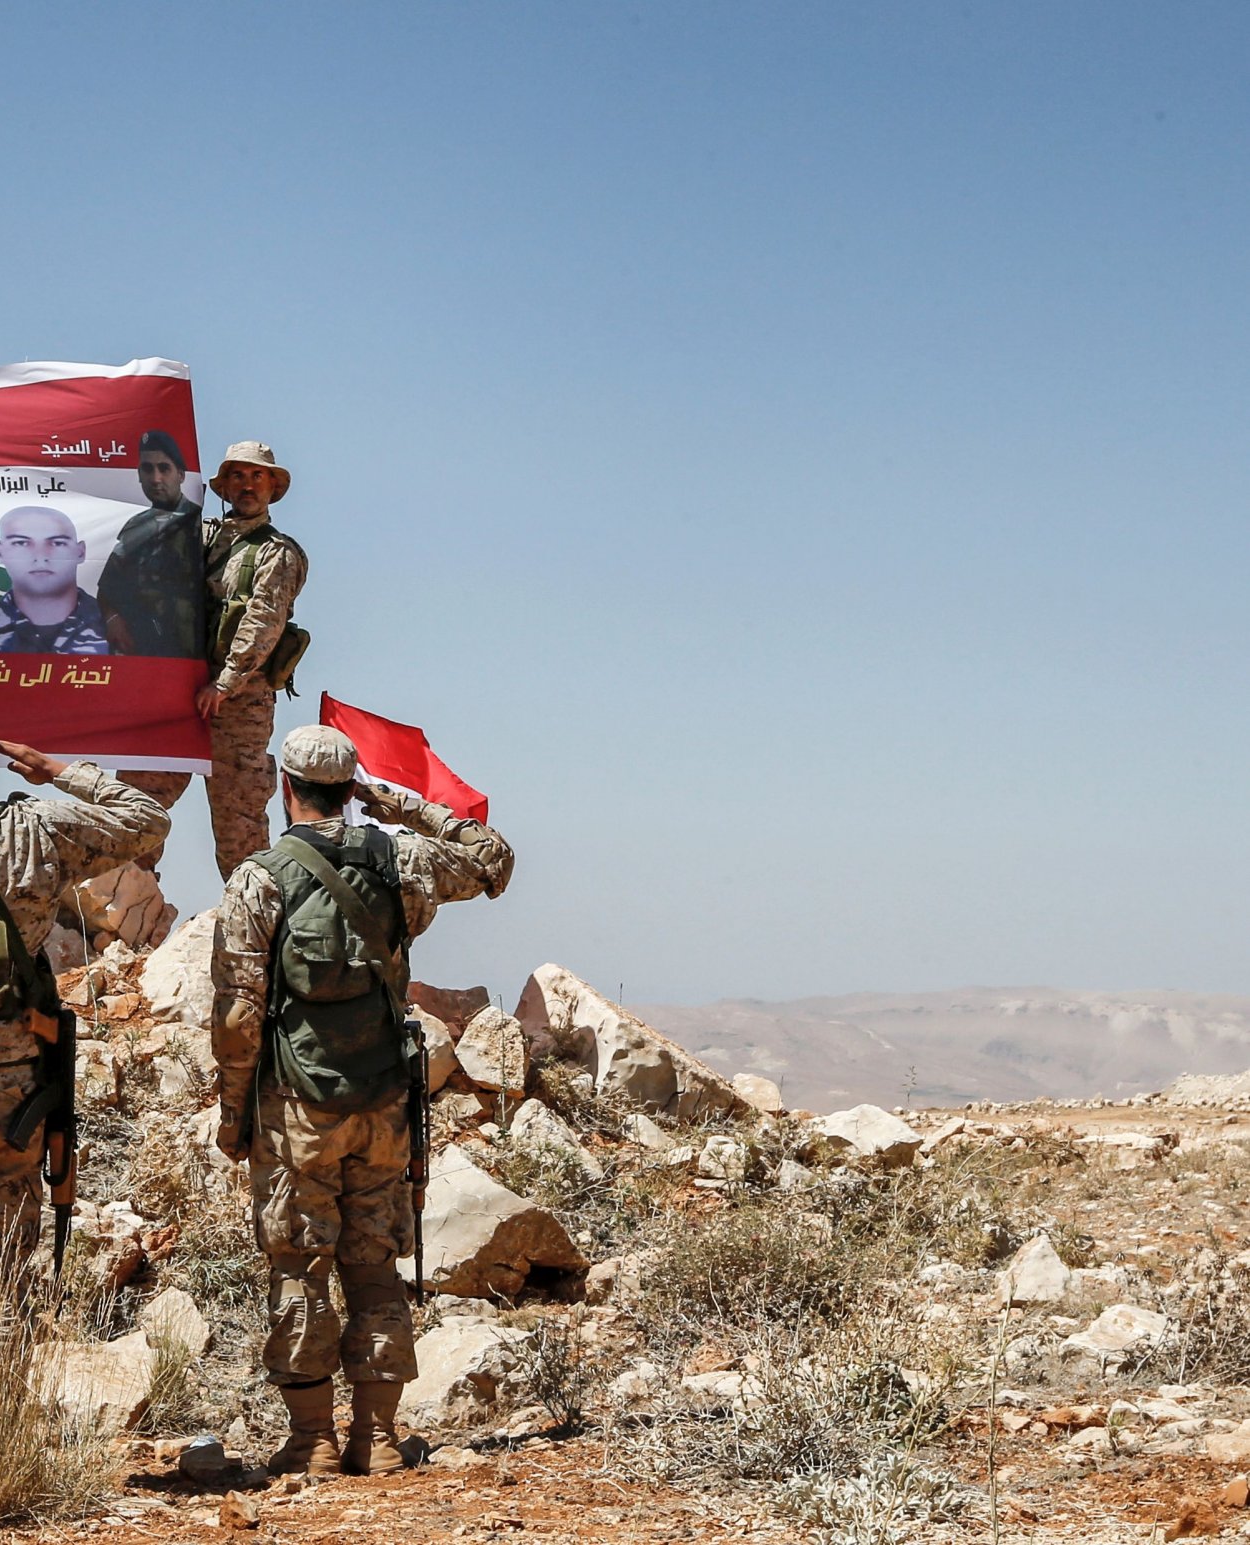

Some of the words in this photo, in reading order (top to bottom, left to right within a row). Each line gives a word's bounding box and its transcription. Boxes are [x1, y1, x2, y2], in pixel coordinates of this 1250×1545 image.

[98, 440, 127, 462] علي
[36, 476, 67, 498] علي
[19, 663, 53, 688] الى
